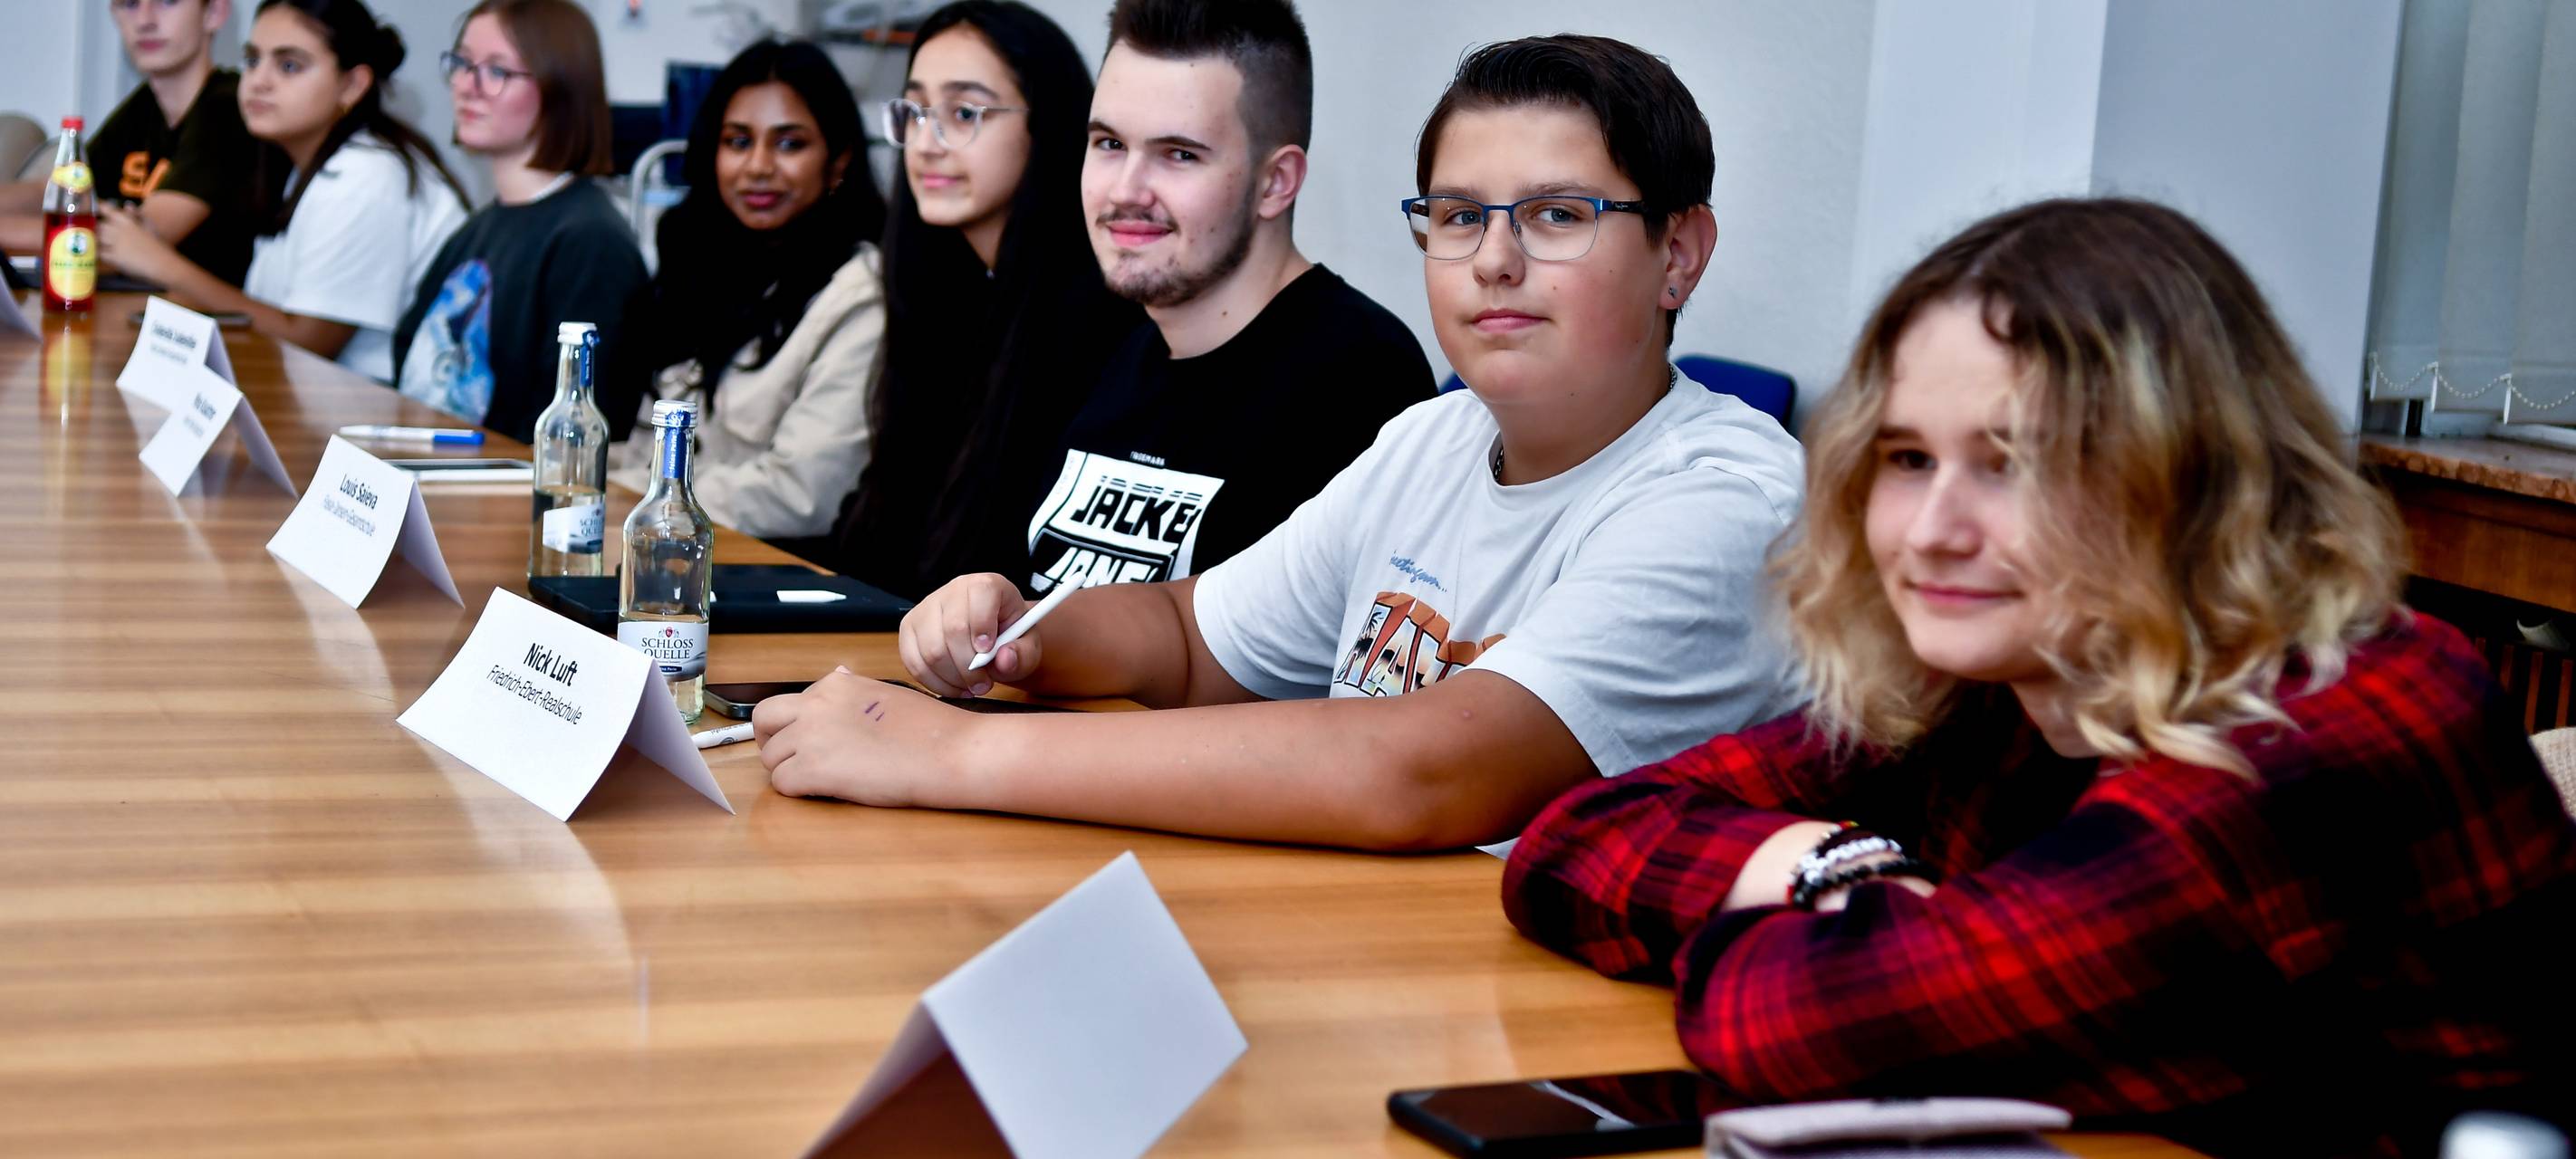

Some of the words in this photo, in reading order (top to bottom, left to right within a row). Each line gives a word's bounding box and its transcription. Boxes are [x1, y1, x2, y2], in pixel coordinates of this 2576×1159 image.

[340, 474, 359, 498] Louis
[356, 483, 379, 510] Saieva
[641, 637, 694, 649] SCHLOSS
[644, 648, 690, 659] QUELLE
[523, 642, 553, 675] Nick
[549, 655, 578, 686] Luft
[486, 665, 582, 725] Friedrich-Ebert-Realschule
